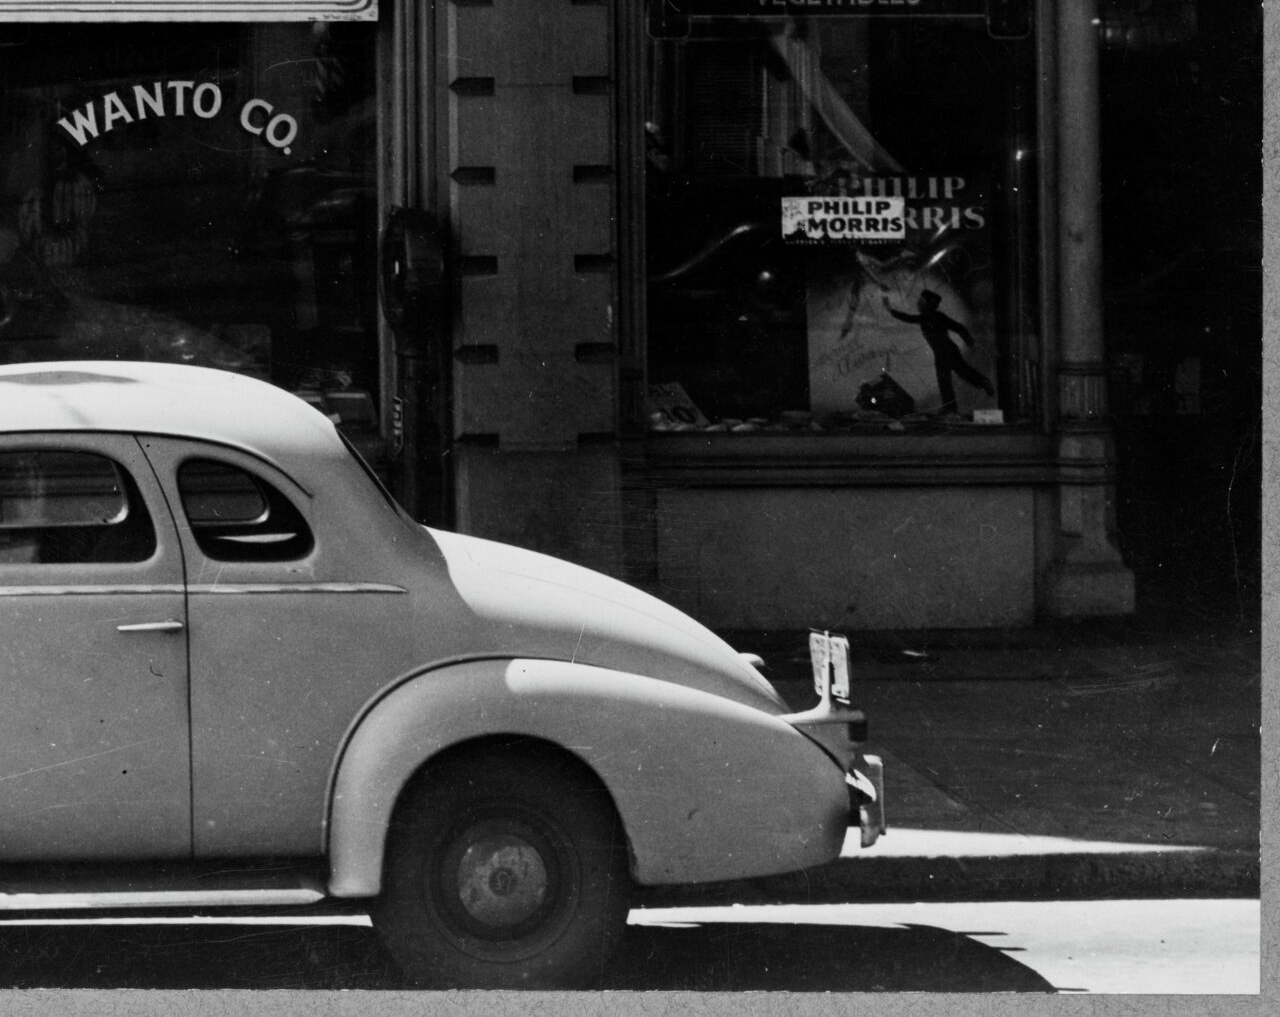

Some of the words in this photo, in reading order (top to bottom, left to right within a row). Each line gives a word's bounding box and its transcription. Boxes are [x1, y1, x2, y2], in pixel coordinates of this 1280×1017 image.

[56, 80, 223, 148] WANTO
[239, 97, 298, 156] CO.
[807, 200, 892, 216] PHILIP
[807, 216, 904, 233] MORRIS
